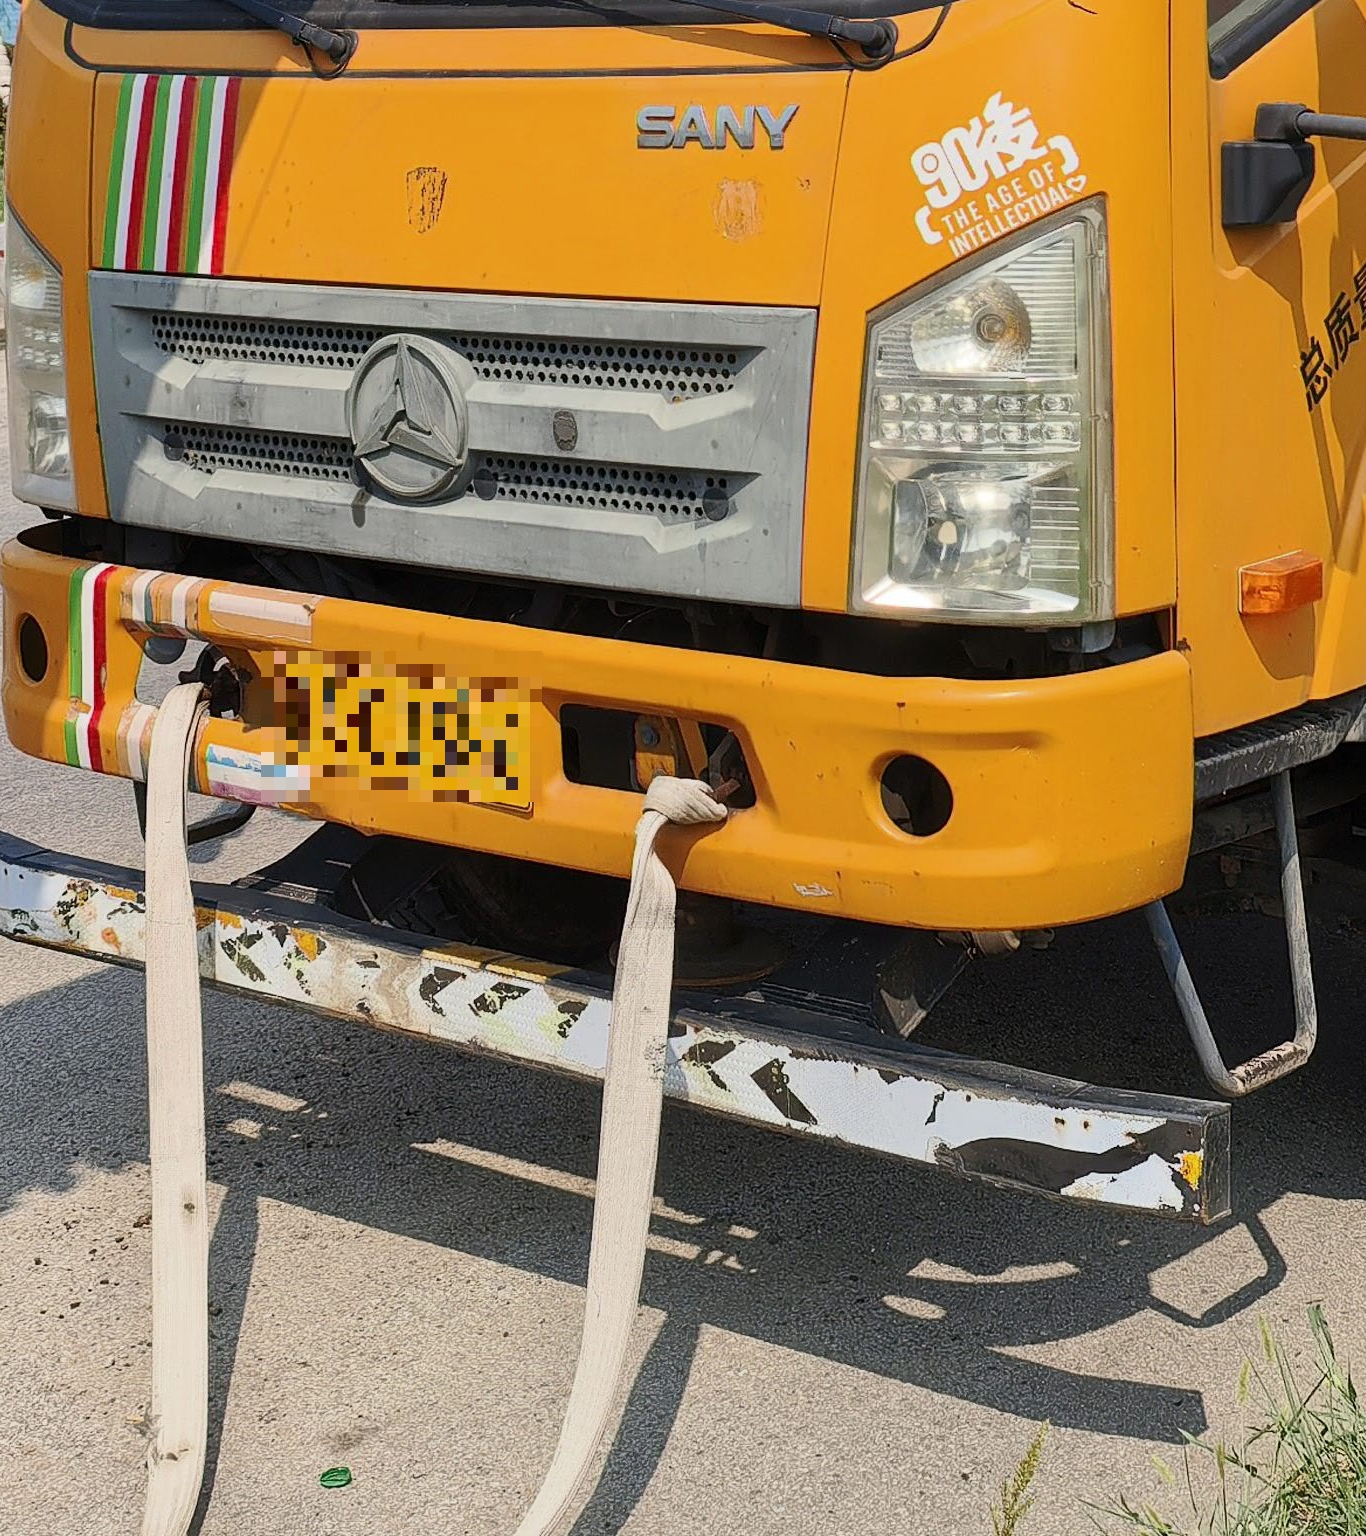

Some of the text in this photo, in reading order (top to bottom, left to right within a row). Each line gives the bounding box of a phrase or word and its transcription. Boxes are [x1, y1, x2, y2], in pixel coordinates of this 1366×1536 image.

[636, 104, 801, 150] SANY
[941, 161, 1057, 235] THE AGE OF
[948, 182, 1074, 258] INTELLECTUAL
